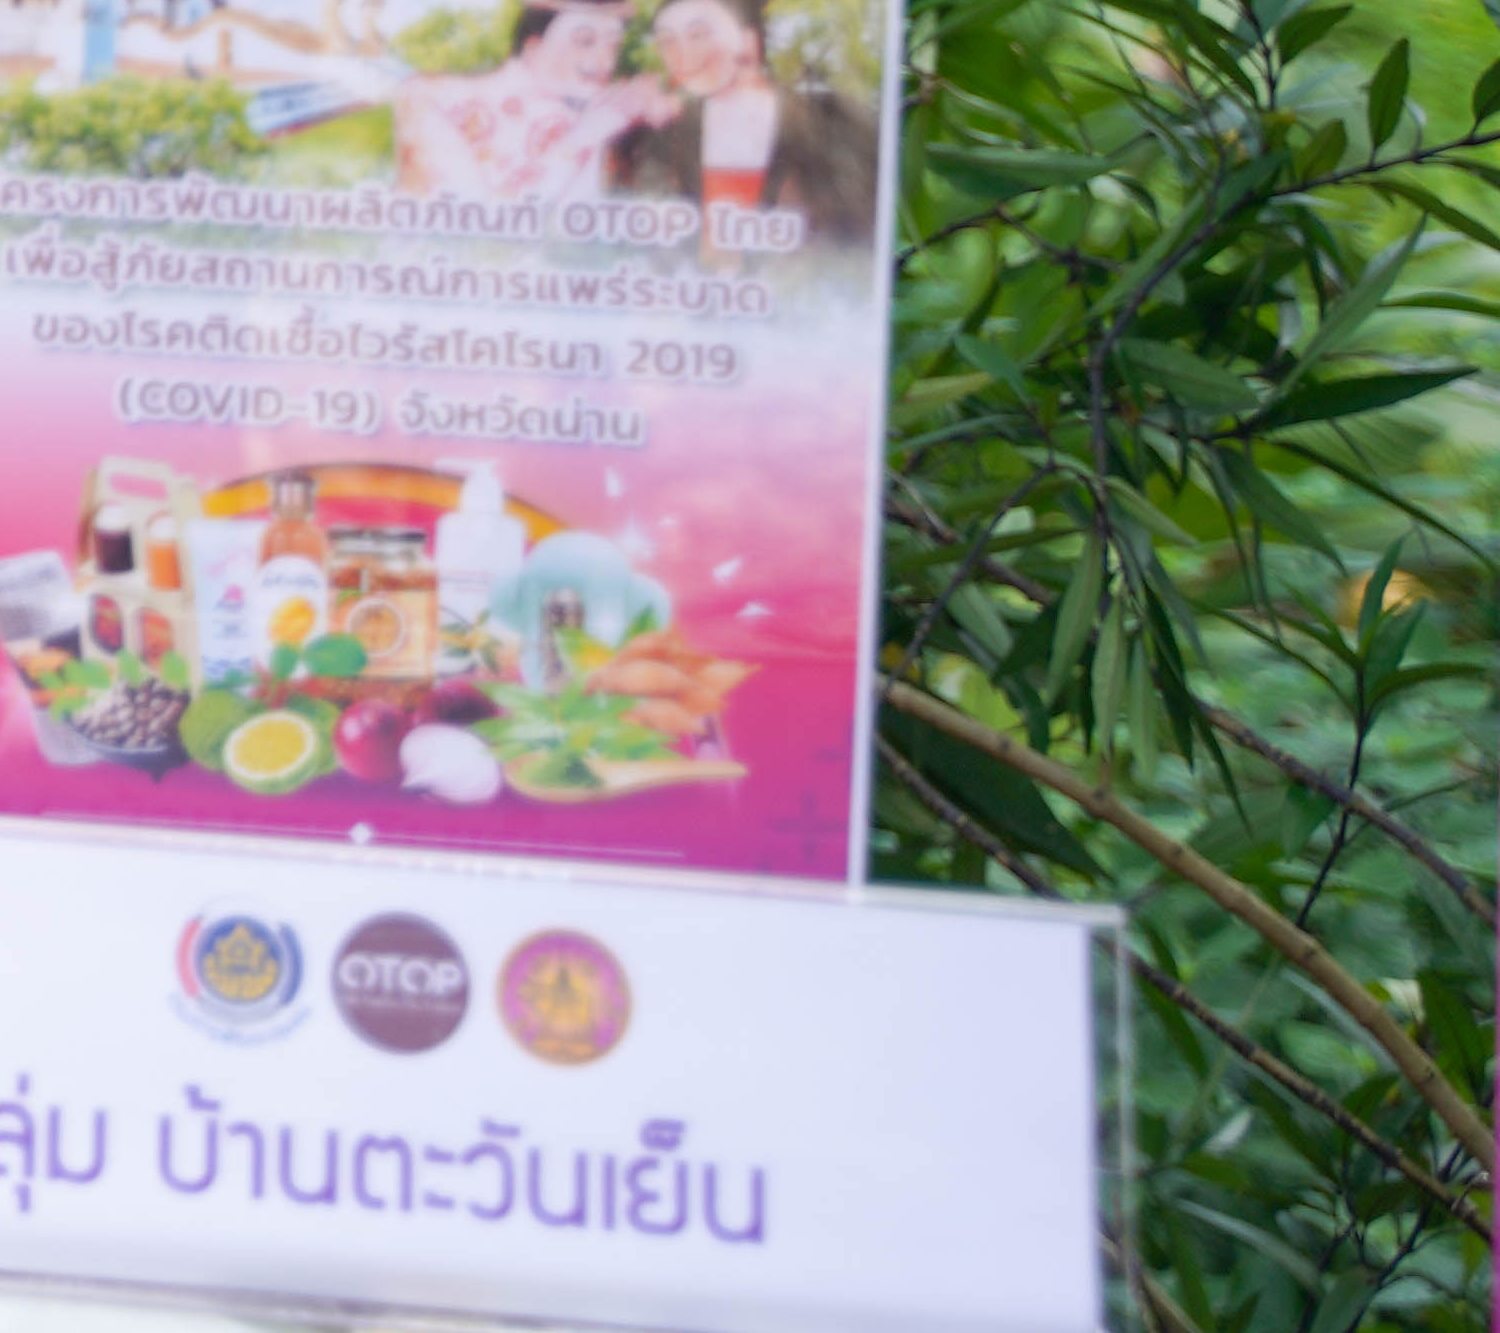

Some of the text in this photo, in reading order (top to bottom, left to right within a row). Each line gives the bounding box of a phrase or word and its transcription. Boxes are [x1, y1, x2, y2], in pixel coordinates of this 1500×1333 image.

[562, 200, 695, 242] OTOP
[711, 205, 797, 247] ไทย
[5, 228, 770, 314] เพื่อสู้ภัยสถานการณ์การแพร่ระบาด
[32, 306, 737, 380] ของโรคติดเชื้อไวรัสโคโรนา 2019
[118, 377, 641, 441] (COVID-19) จังหวัดน่าน
[338, 953, 463, 995] OTOP
[158, 1083, 765, 1245] บ้านตะวันเย็น
